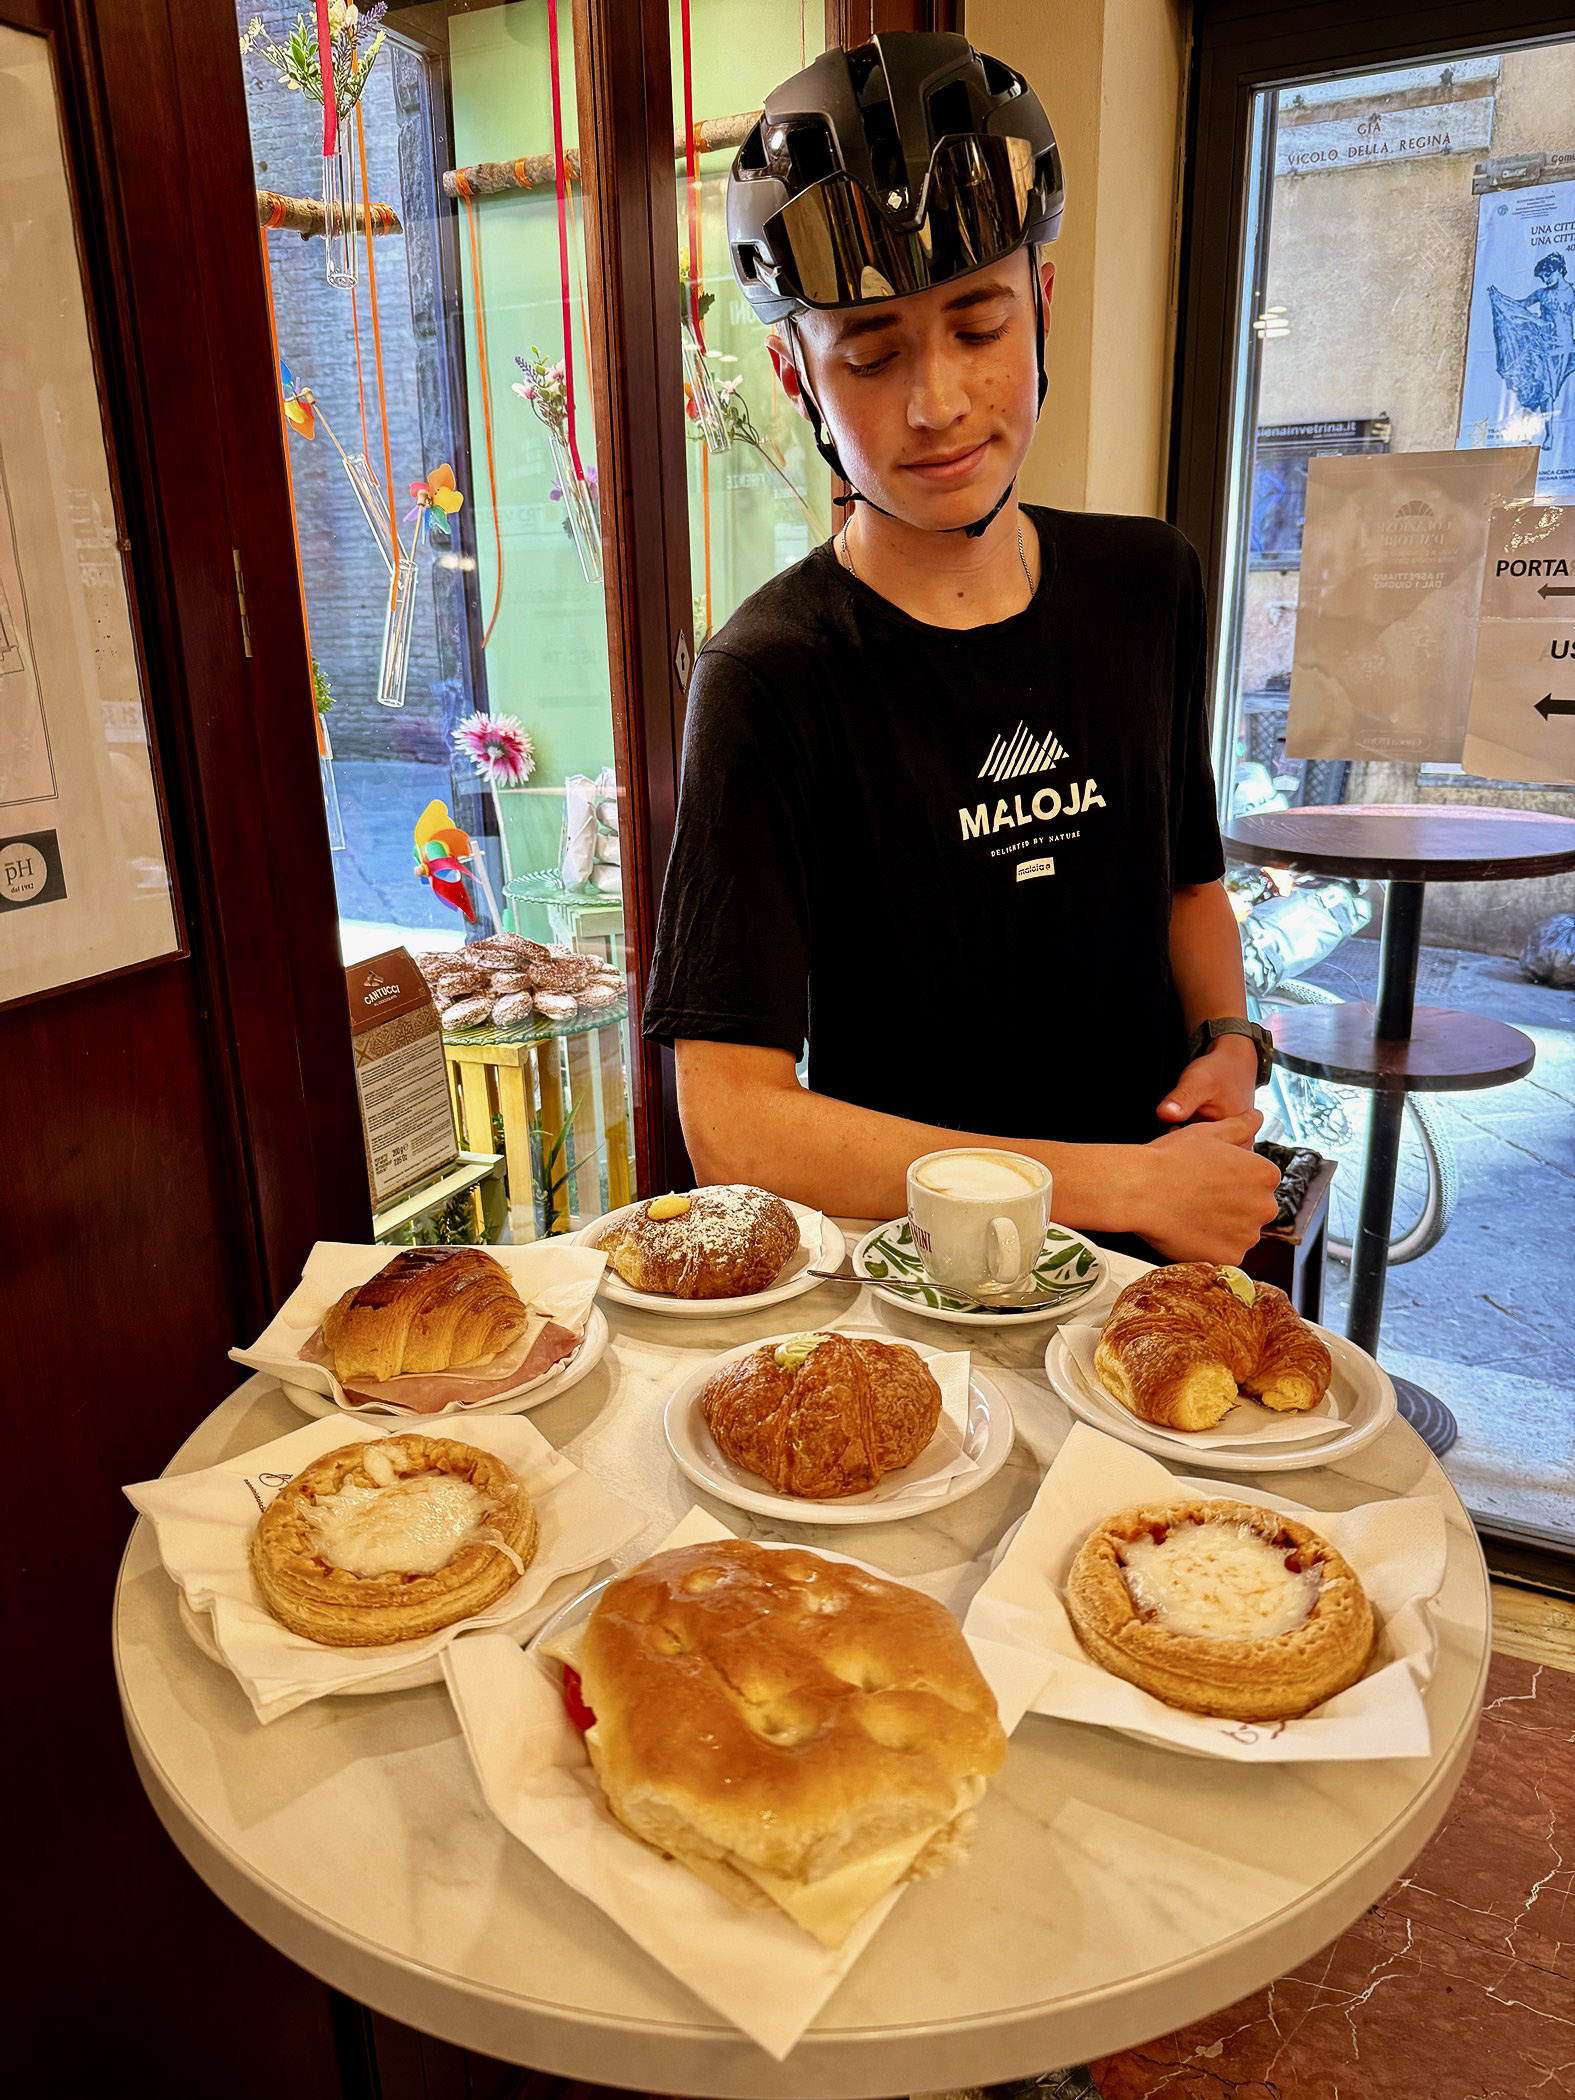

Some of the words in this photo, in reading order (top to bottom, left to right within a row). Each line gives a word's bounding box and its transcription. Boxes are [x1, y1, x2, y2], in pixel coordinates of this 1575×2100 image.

[1288, 149, 1338, 166] VICOLO
[1348, 142, 1390, 158] DELLA
[1399, 132, 1451, 151] REGINA
[1531, 225, 1552, 235] UNA
[1553, 221, 1575, 232] CITT
[1530, 236, 1551, 246] UNA
[1553, 233, 1575, 243] CITT
[1496, 559, 1569, 577] PORTA
[958, 778, 1107, 840] MALOJA
[1049, 830, 1081, 843] NATURE
[364, 985, 400, 1005] CANTUCCI
